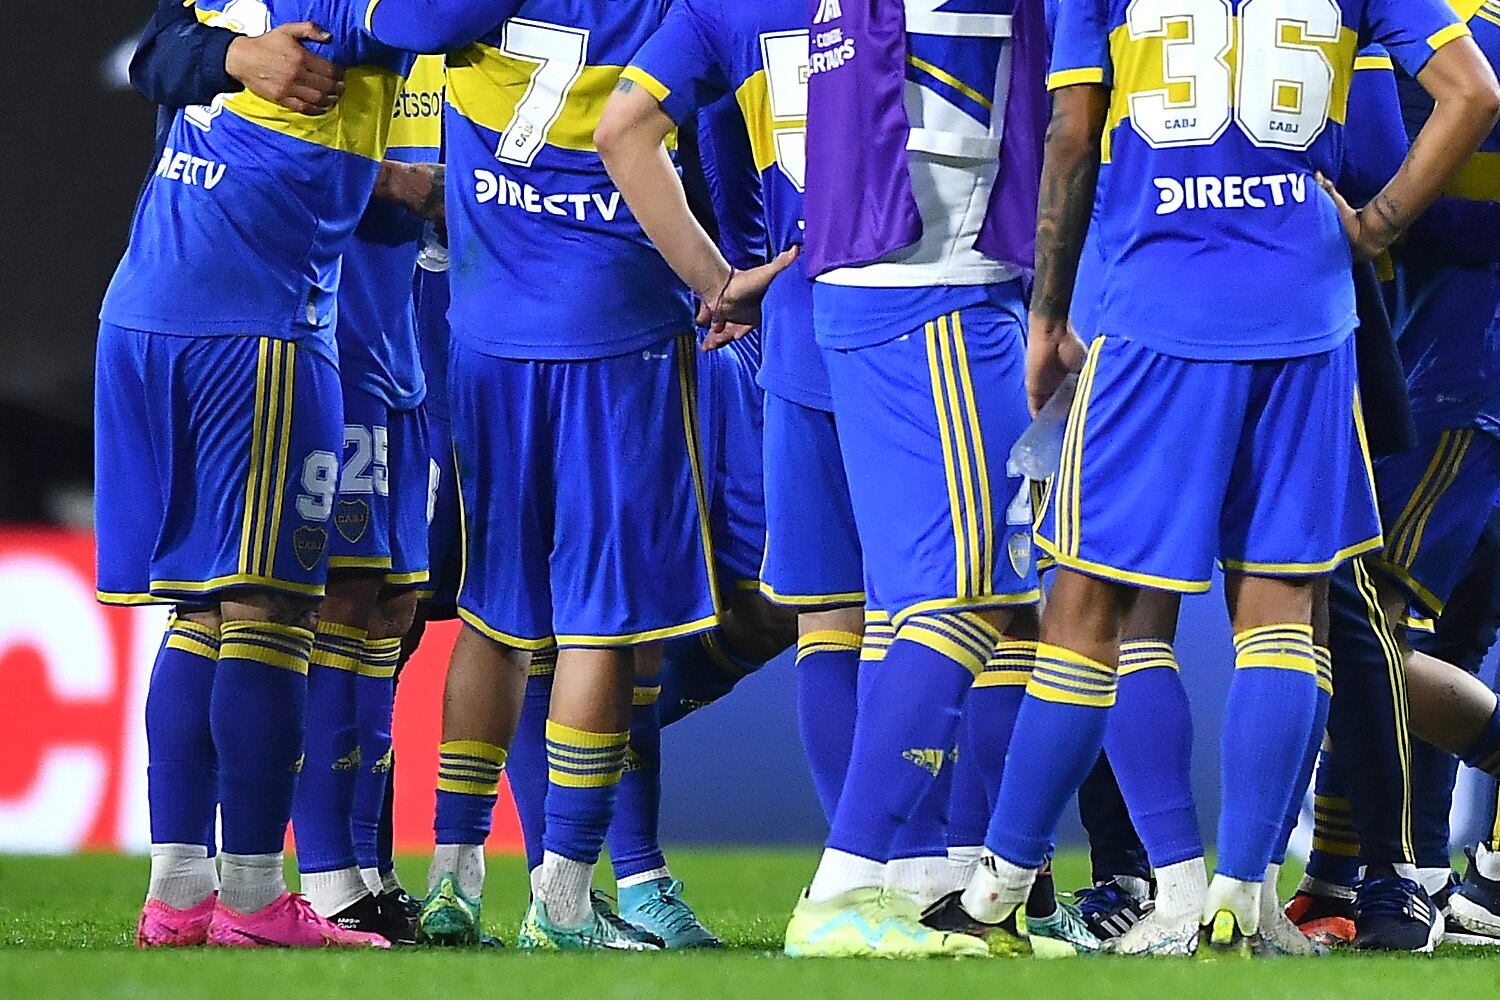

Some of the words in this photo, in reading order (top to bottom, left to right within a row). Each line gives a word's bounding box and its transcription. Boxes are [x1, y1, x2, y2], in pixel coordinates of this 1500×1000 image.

[494, 16, 591, 168] 7
[1164, 118, 1197, 130] CABJ
[1269, 120, 1299, 134] CABJ
[473, 168, 621, 222] DIRECTV
[1153, 172, 1307, 215] DIRECTV
[295, 449, 340, 523] 9
